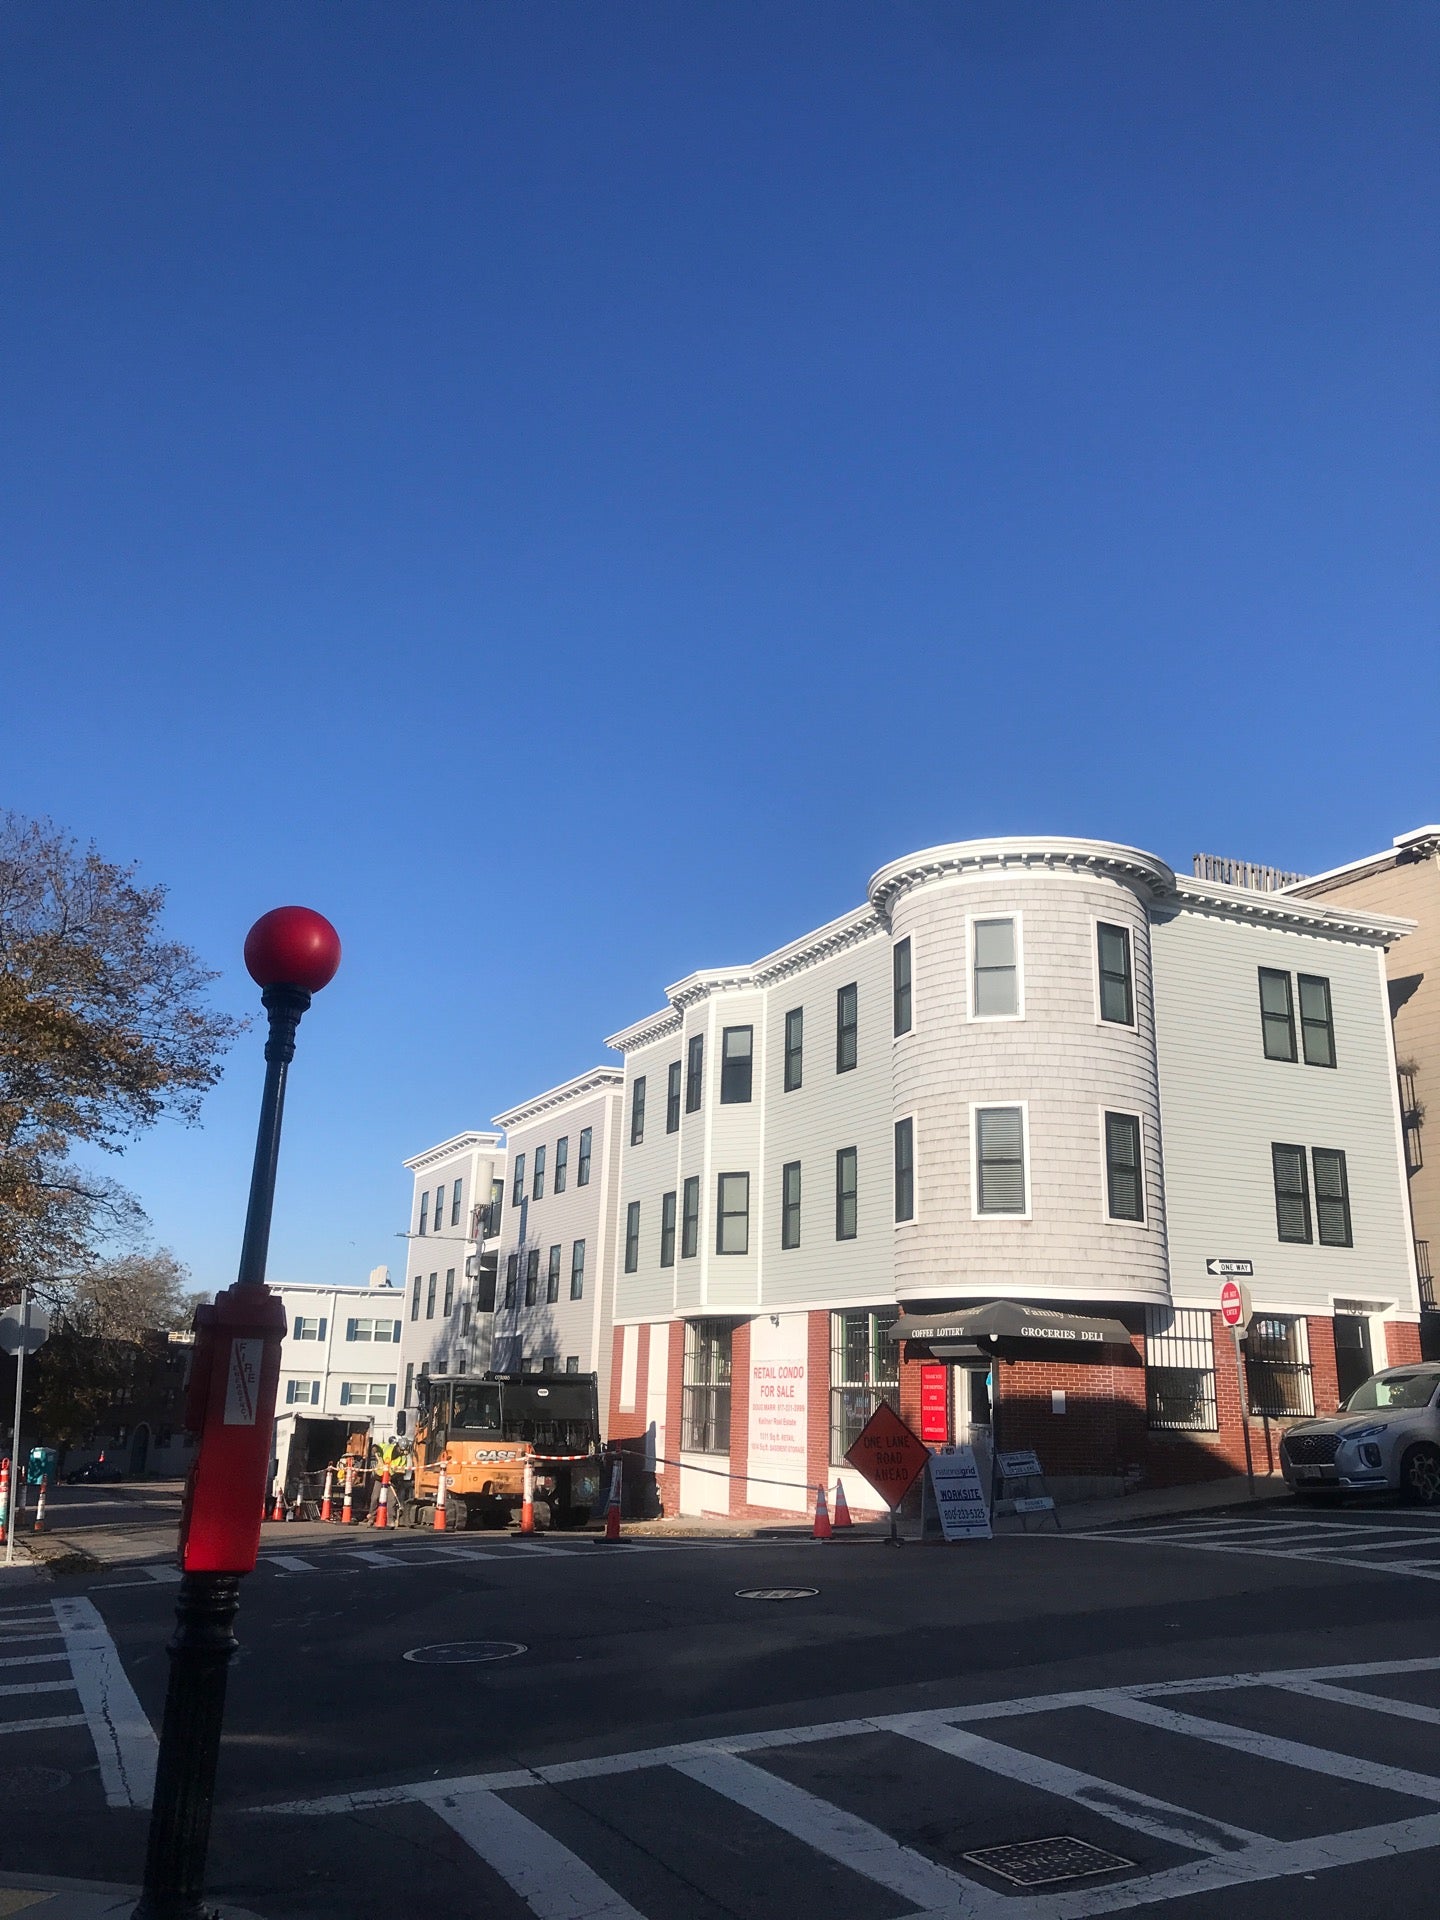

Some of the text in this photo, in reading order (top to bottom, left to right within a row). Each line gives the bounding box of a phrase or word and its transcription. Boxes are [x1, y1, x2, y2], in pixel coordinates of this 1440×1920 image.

[1221, 1263, 1234, 1271] ONE
[1021, 1307, 1064, 1319] Family
[911, 1327, 965, 1338] COFFEE LOTTERY
[1021, 1326, 1104, 1341] GROCERIES DELI
[239, 1343, 256, 1383] FIRE
[754, 1366, 804, 1379] RETAIL CONDO
[760, 1385, 795, 1398] FOR SALE
[864, 1435, 910, 1448] ONE LANE
[475, 1450, 516, 1461] CASE
[876, 1452, 902, 1465] ROAD
[874, 1468, 908, 1481] AHEAD
[935, 1466, 976, 1478] nationalgrid
[940, 1488, 980, 1499] WORKSITE
